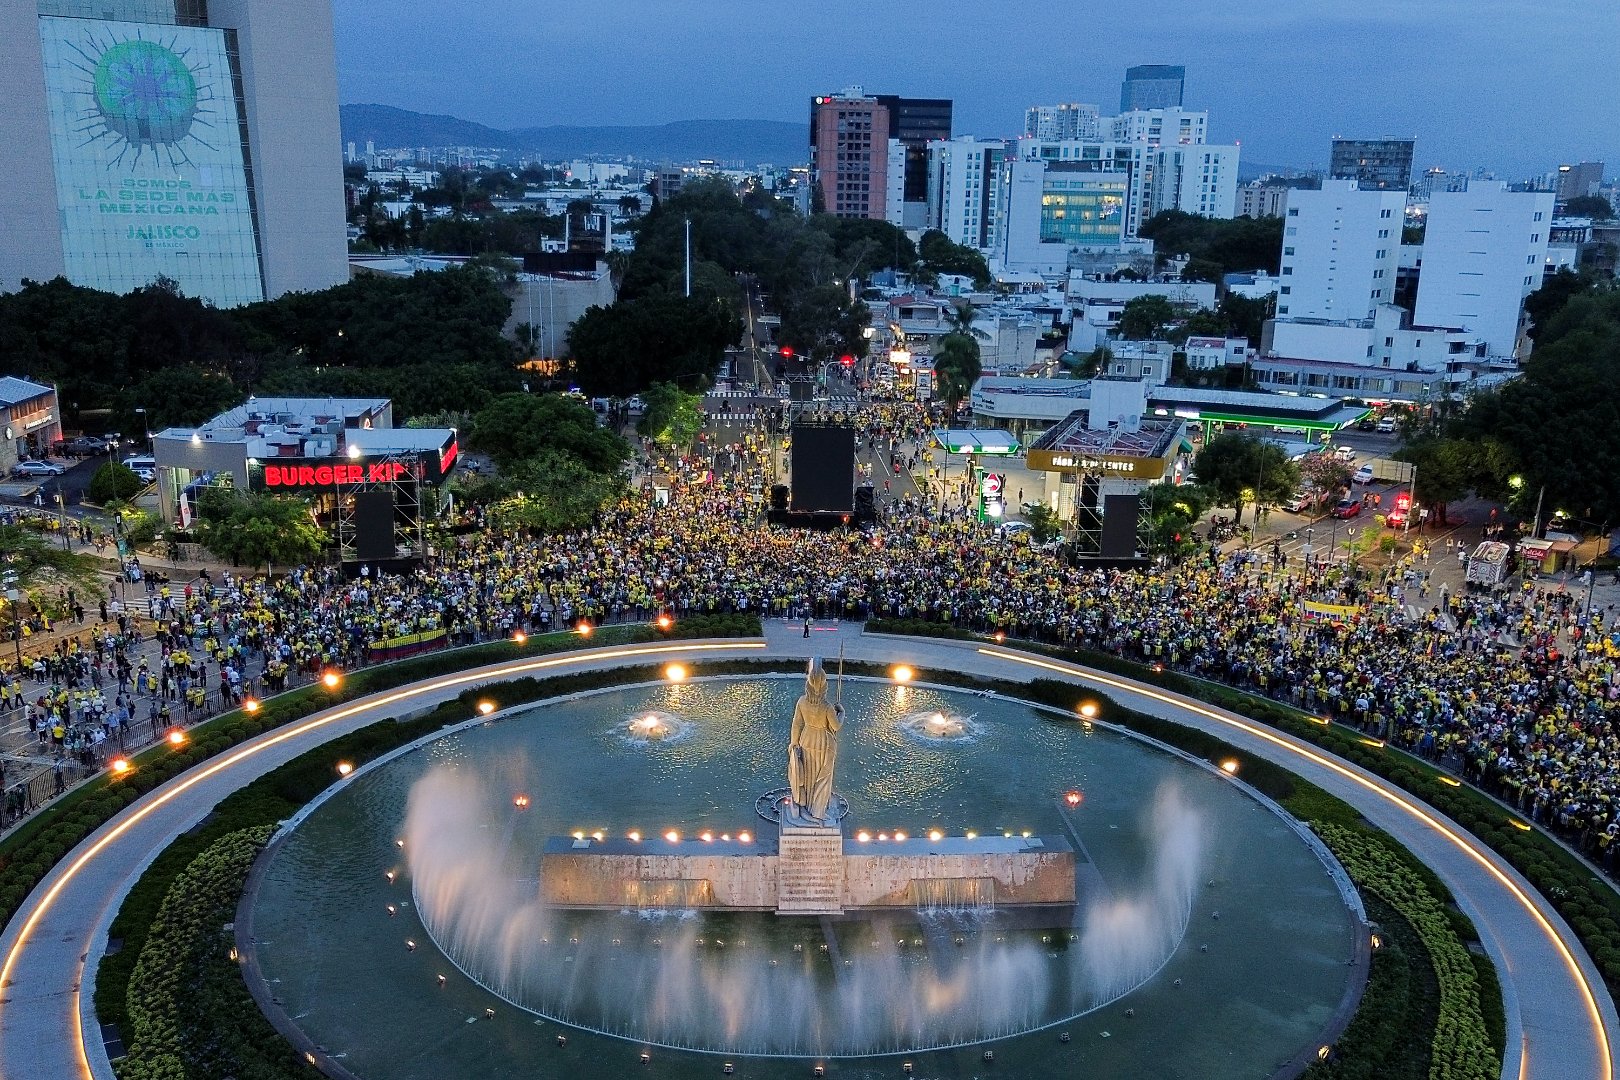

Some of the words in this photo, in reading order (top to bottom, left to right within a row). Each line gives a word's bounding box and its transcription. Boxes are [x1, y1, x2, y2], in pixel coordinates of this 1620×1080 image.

[122, 178, 192, 189] SOMOS
[78, 188, 110, 200] LA
[118, 189, 178, 201] SEDE
[99, 202, 219, 215] MEXICANA
[126, 224, 201, 240] JALISCO
[265, 464, 363, 486] BURGER
